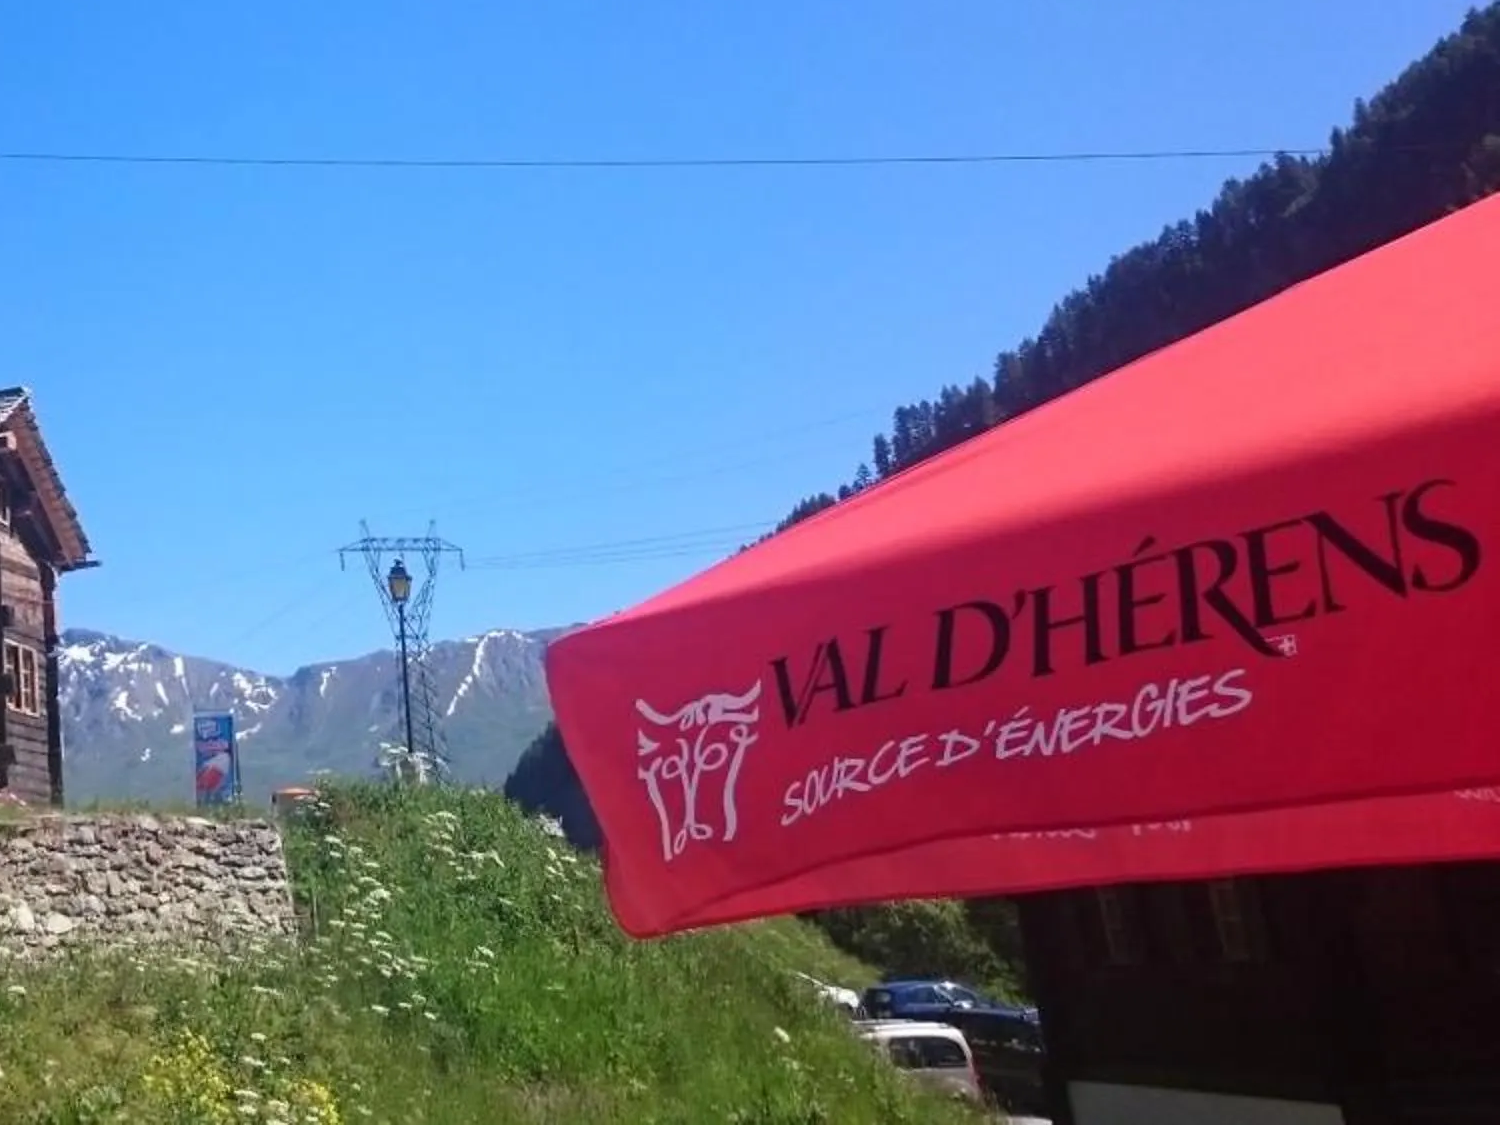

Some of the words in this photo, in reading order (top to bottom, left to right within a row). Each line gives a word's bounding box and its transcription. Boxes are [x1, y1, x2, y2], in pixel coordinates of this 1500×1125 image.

[768, 624, 909, 730] VAL
[930, 478, 1481, 690] D'HÉRENS
[780, 733, 931, 826] SOURCE
[935, 669, 1254, 767] D'ÉNERGIES
